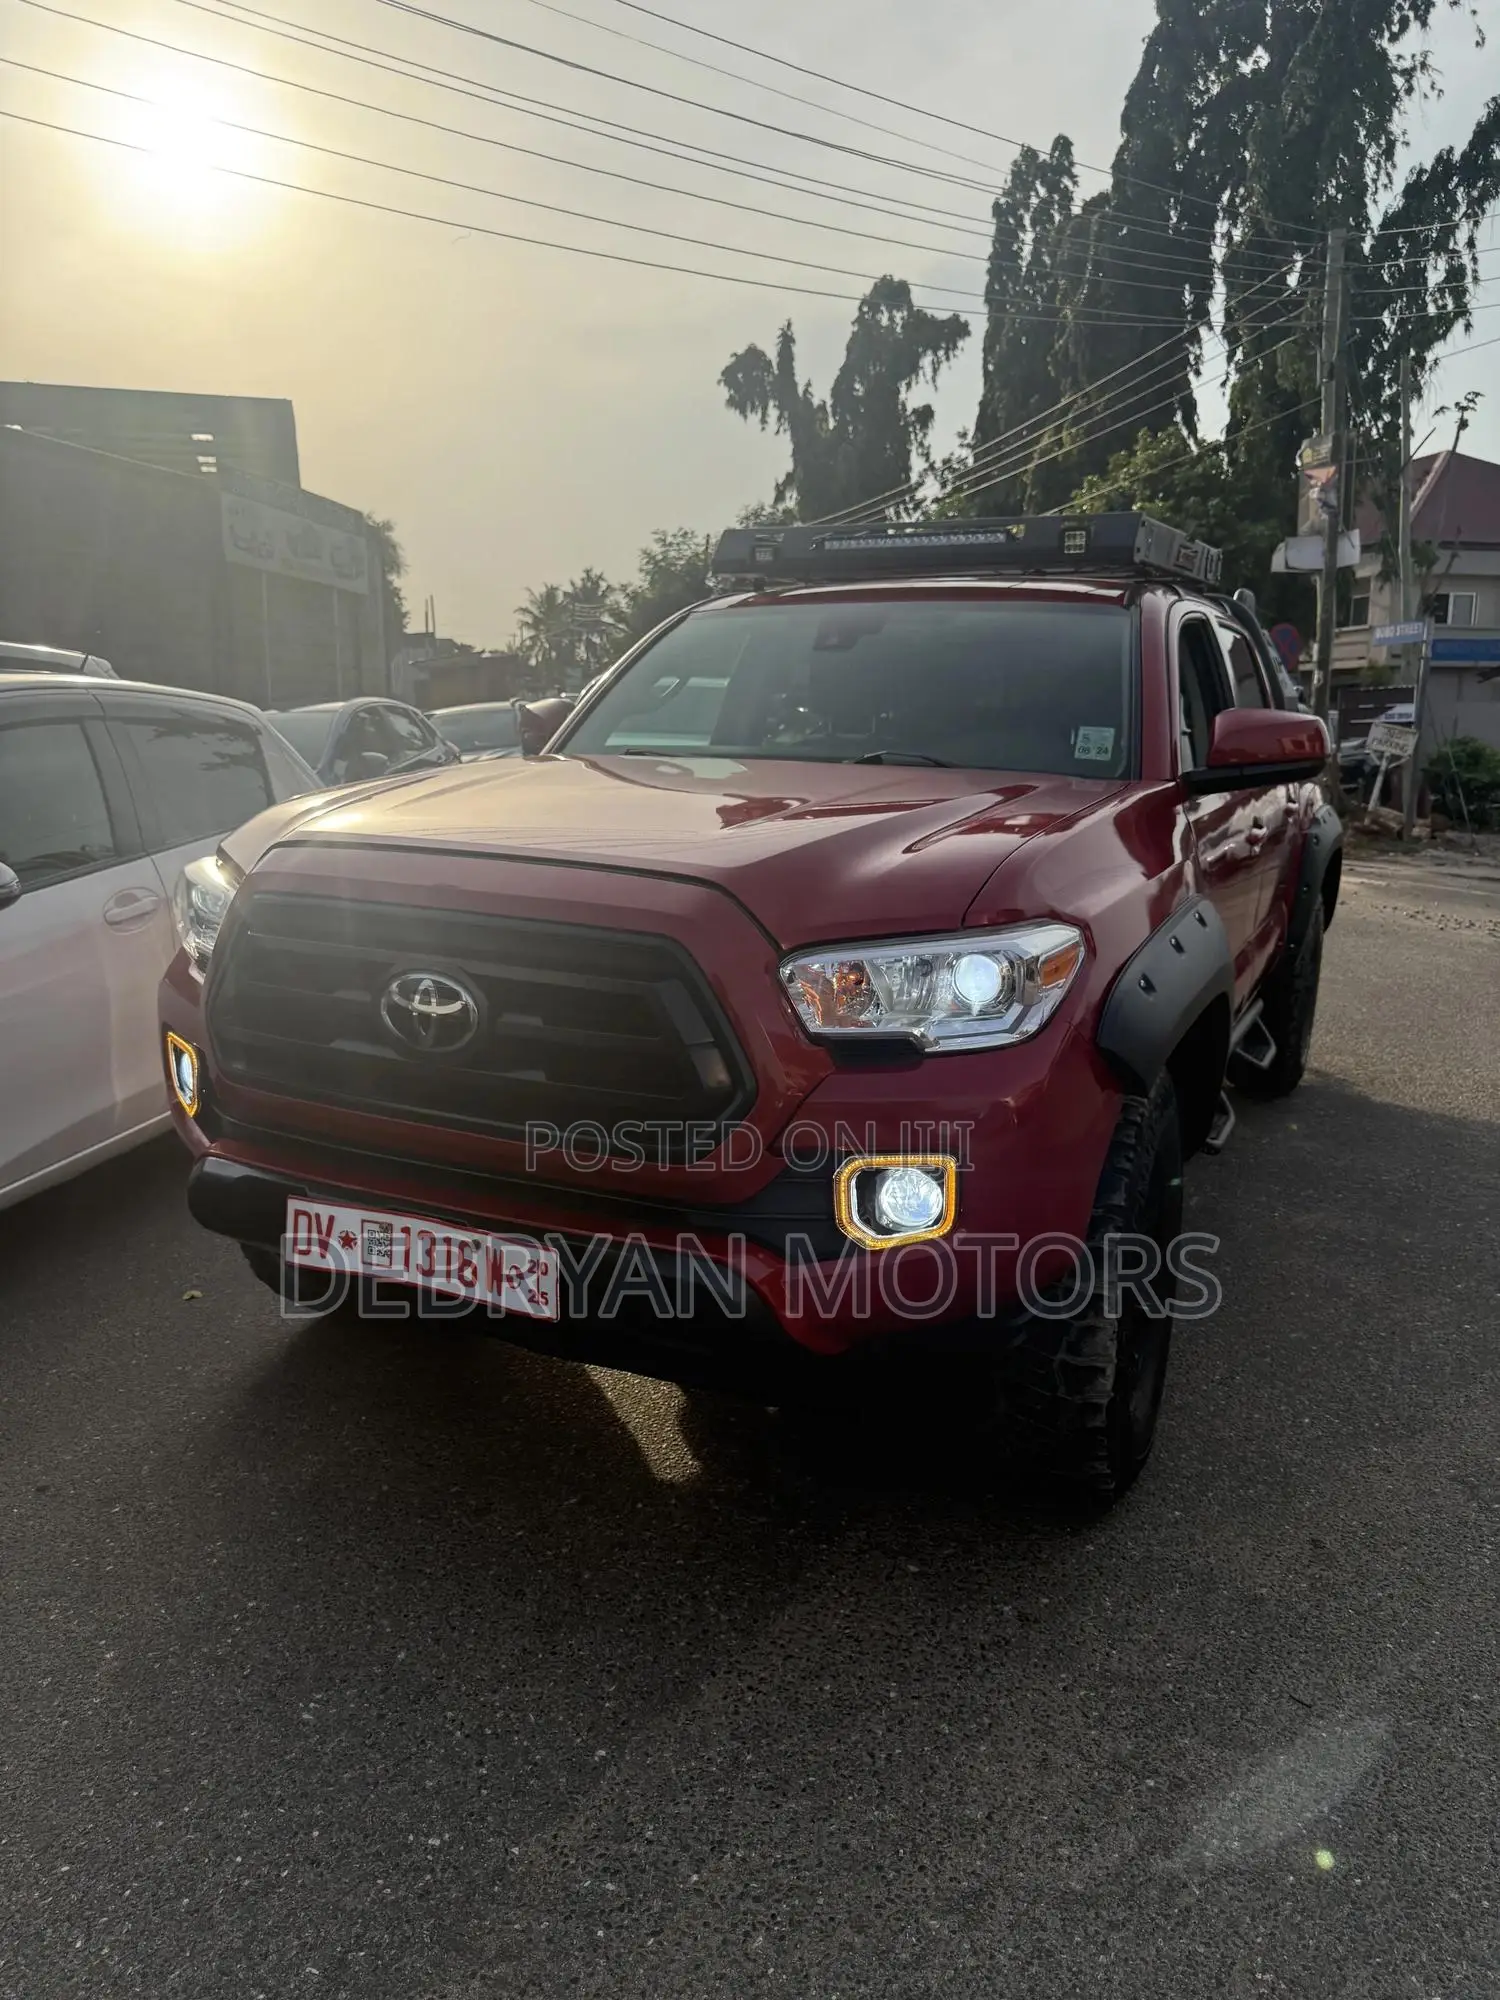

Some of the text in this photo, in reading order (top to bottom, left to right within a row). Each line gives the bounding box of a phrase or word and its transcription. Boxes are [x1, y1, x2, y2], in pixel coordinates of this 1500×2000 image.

[1096, 746, 1109, 755] 24
[292, 1208, 336, 1260] DV
[400, 1225, 478, 1289] 1316
[527, 1258, 549, 1277] 20
[527, 1288, 549, 1306] 25
